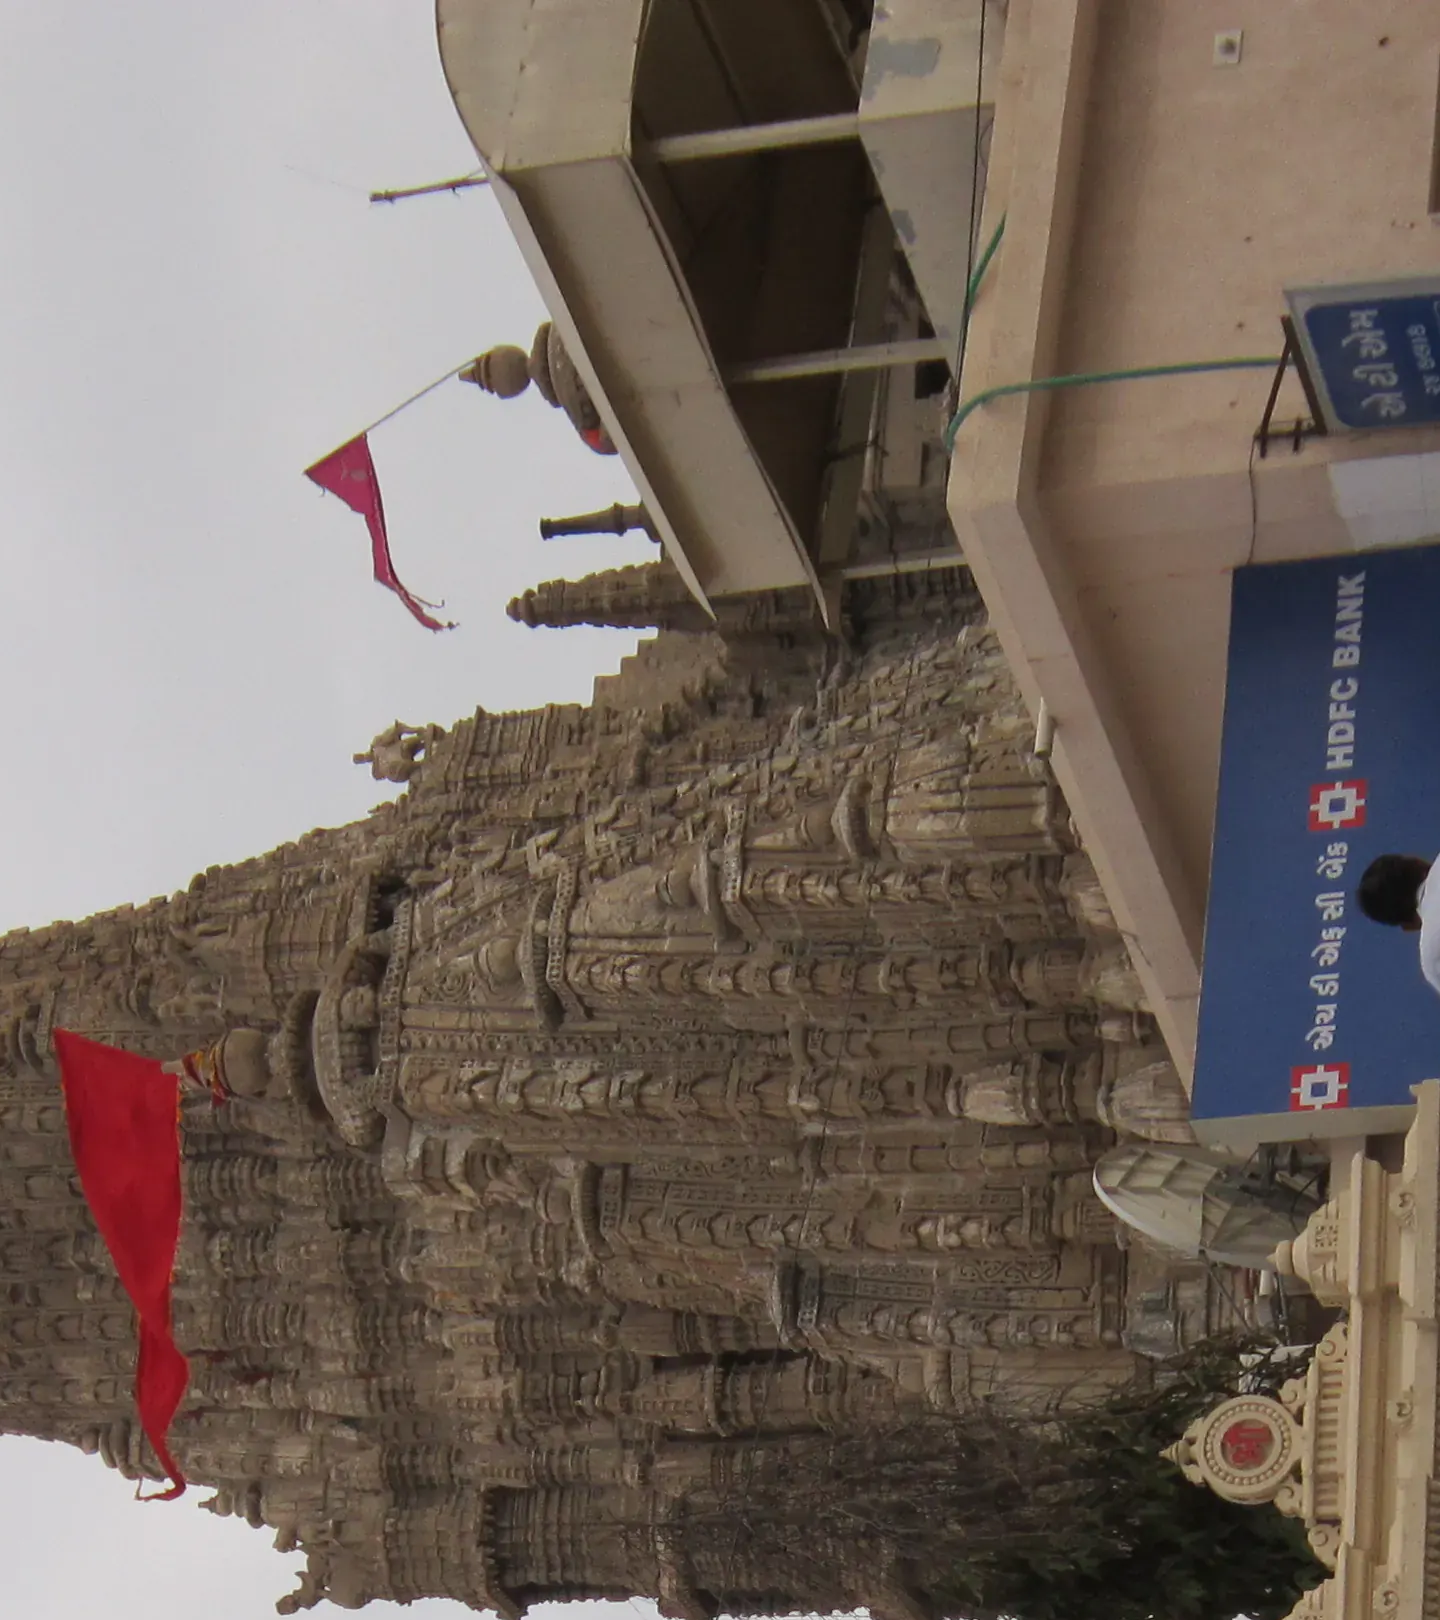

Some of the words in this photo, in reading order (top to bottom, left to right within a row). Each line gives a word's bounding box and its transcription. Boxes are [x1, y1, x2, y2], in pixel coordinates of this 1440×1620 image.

[1331, 570, 1366, 668] BANK
[1324, 676, 1359, 771] HDFC
[1315, 840, 1349, 879] બેંક
[1314, 890, 1346, 922] સી
[1309, 972, 1340, 997] ડી
[1304, 1003, 1338, 1051] એચ
